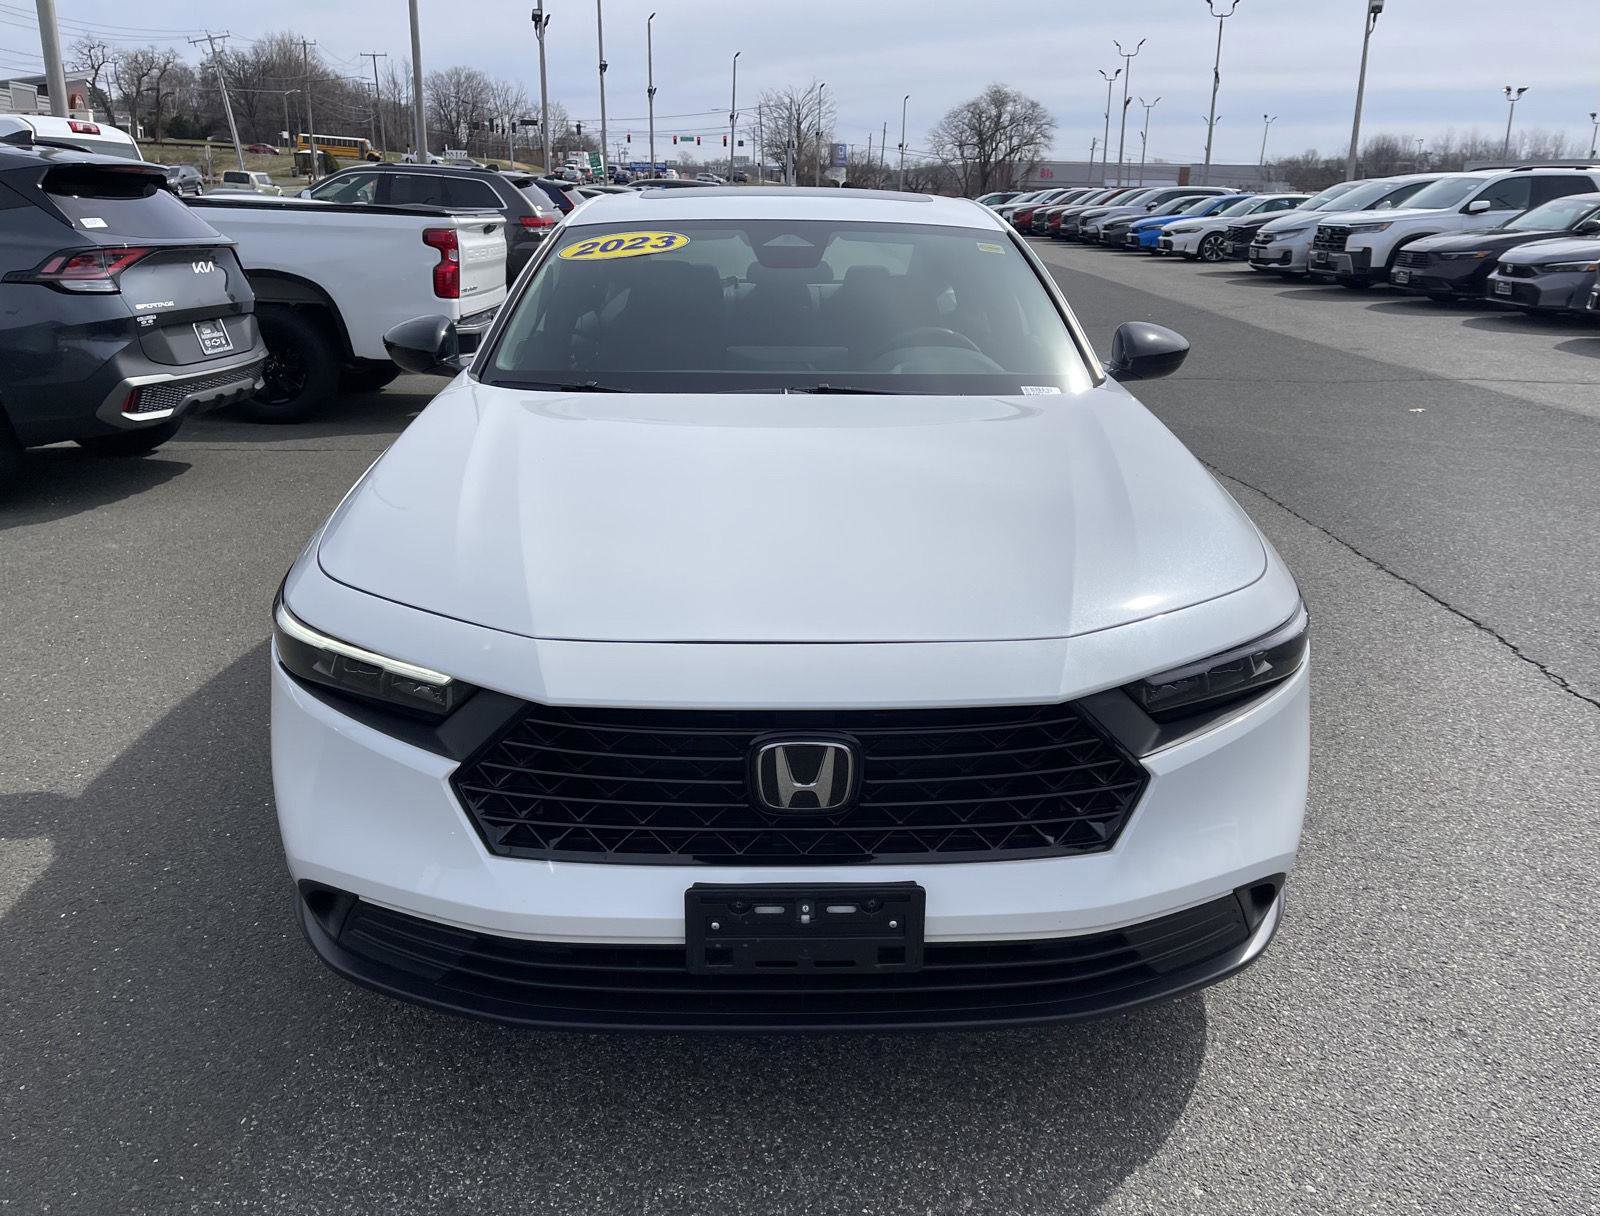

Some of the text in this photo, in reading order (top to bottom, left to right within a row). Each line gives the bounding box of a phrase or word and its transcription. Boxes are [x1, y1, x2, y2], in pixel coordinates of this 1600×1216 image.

[570, 235, 677, 257] 2023
[192, 261, 215, 274] KIA
[135, 301, 175, 310] SPORTAGE
